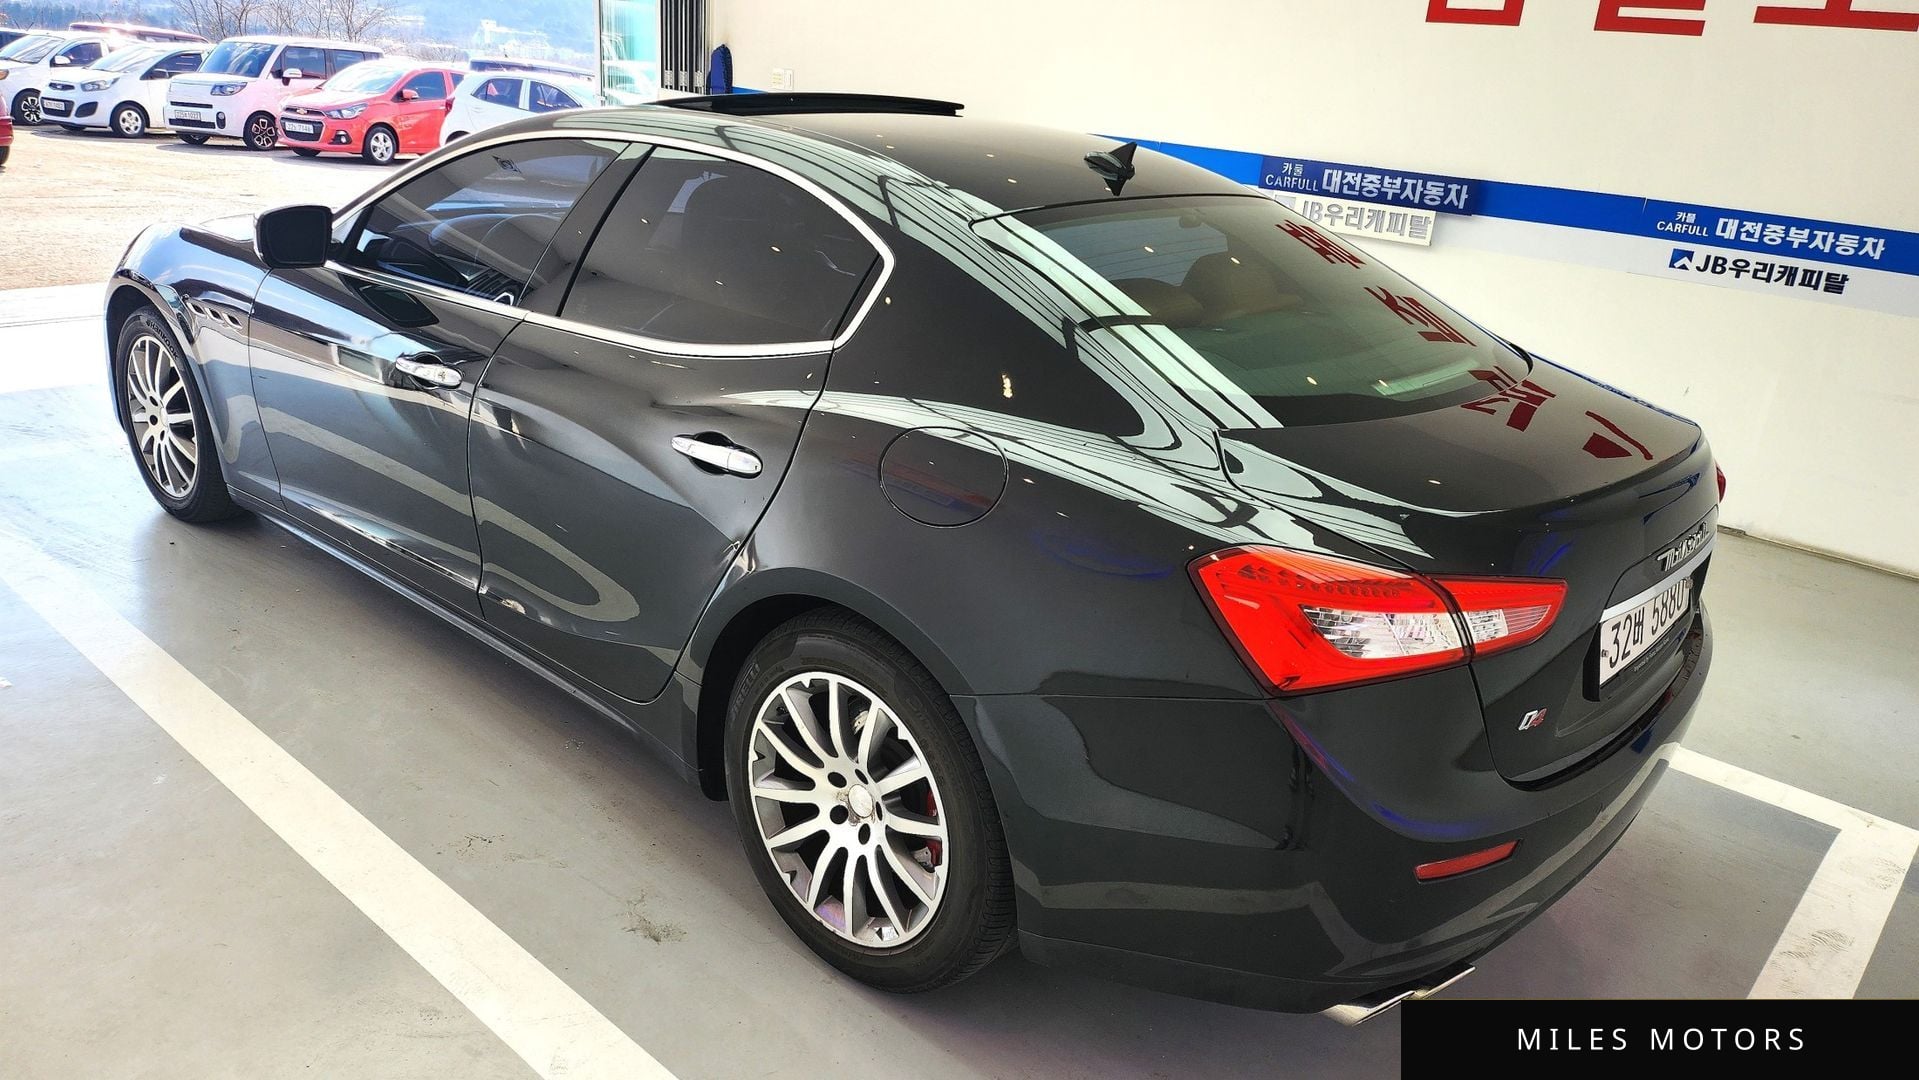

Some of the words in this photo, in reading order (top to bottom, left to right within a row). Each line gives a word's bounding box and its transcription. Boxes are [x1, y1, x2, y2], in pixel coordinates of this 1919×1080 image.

[1265, 174, 1319, 192] CARFULL
[1322, 168, 1469, 210] 대전중부자동차
[1656, 221, 1709, 237] CARFULL
[1715, 217, 1886, 260] 대전중부자동차
[1695, 254, 1850, 295] JB우리캐피탈
[1651, 579, 1686, 636] 5880
